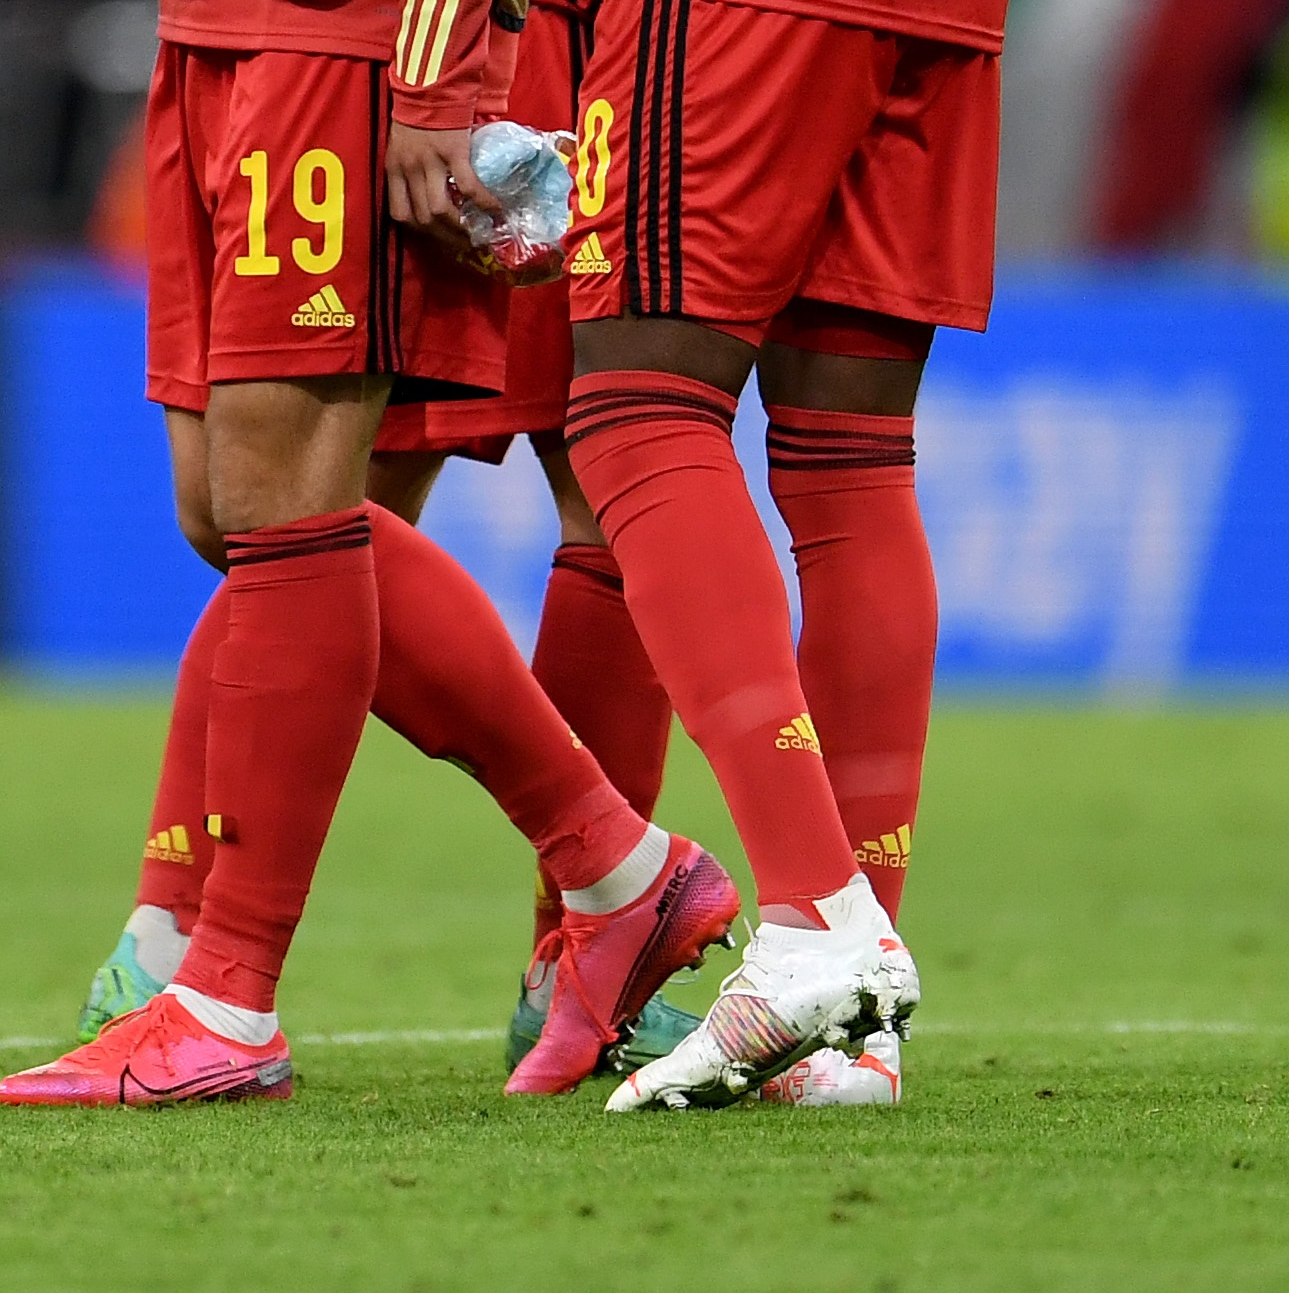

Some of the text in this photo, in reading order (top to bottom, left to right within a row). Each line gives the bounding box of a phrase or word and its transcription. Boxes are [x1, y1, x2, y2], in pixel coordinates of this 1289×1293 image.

[234, 148, 346, 276] 19
[570, 257, 612, 275] adidas
[291, 310, 356, 328] adidas
[774, 735, 823, 756] adid
[854, 849, 911, 868] adida
